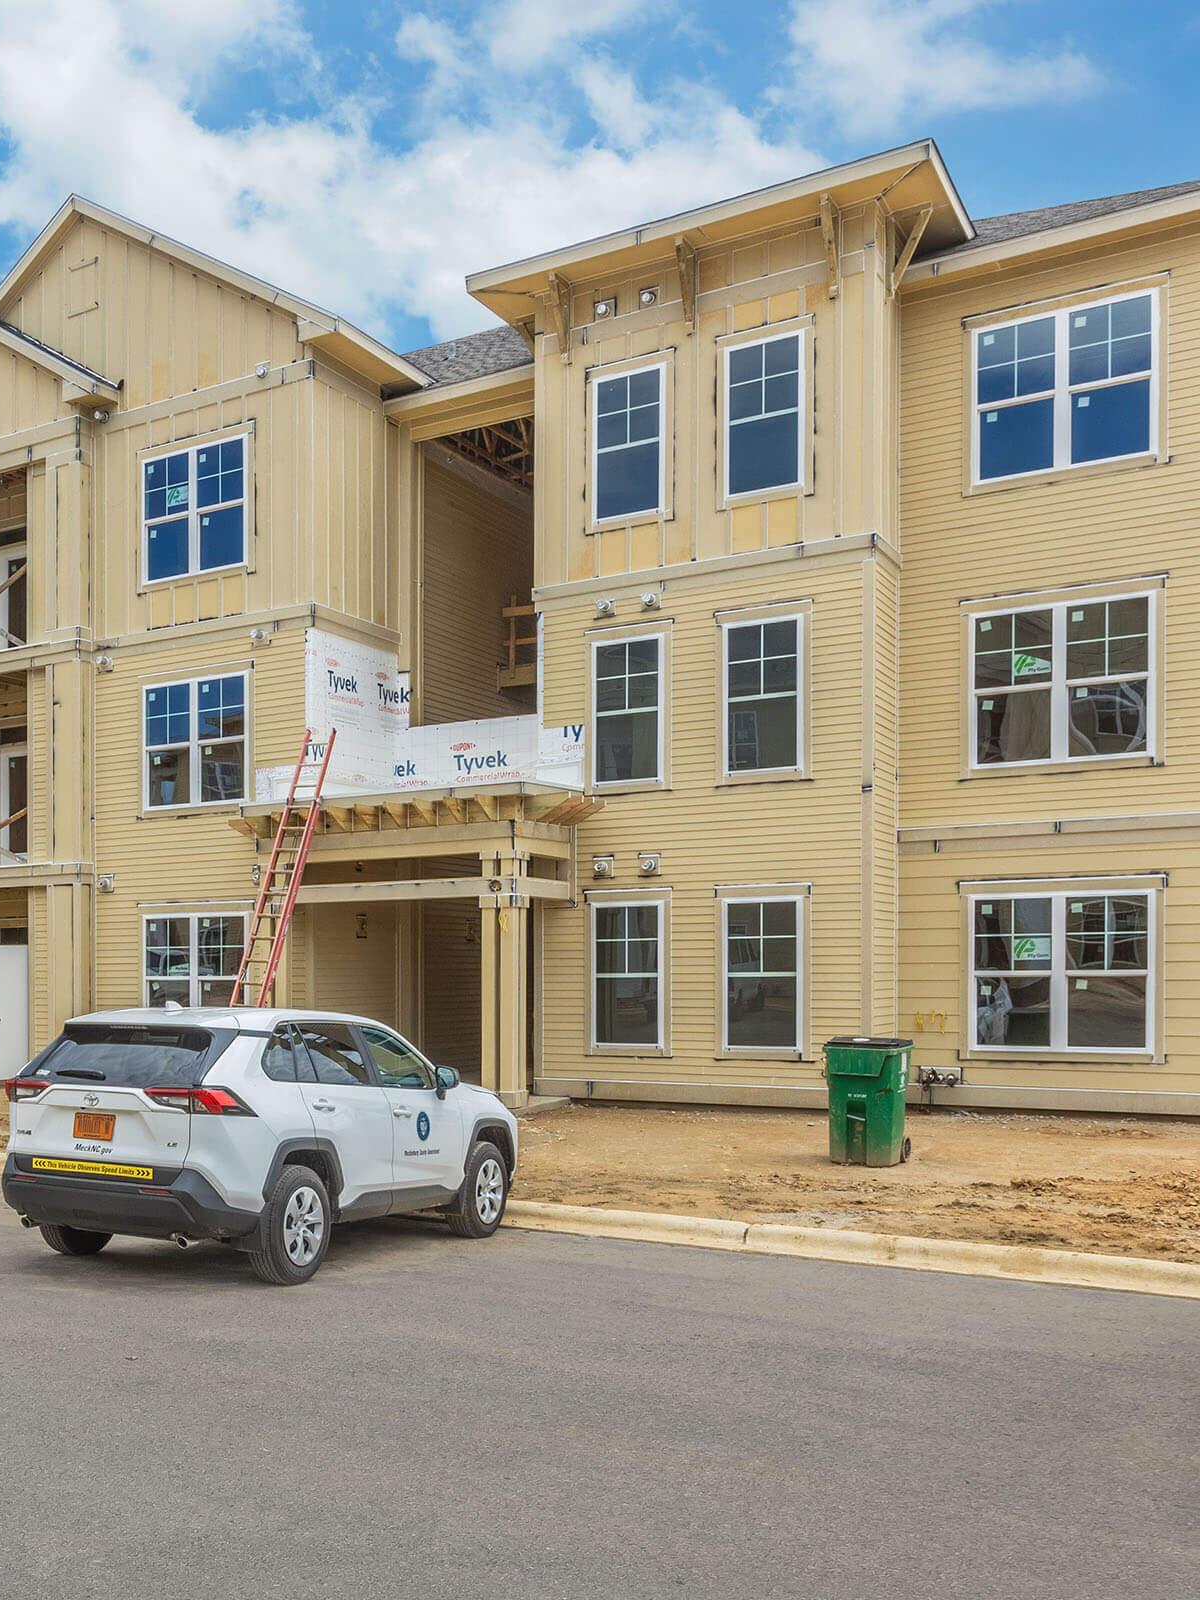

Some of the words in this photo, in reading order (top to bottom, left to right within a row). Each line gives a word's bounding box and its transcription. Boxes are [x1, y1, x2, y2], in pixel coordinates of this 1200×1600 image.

[328, 670, 358, 693] Tyvek
[394, 760, 416, 777] ek
[453, 750, 508, 775] Tyvek
[73, 1143, 113, 1155] MeckNC.gov
[58, 1162, 77, 1170] Vehicle
[77, 1164, 101, 1172] Observes
[101, 1165, 118, 1175] Speed
[118, 1167, 135, 1175] Limits
